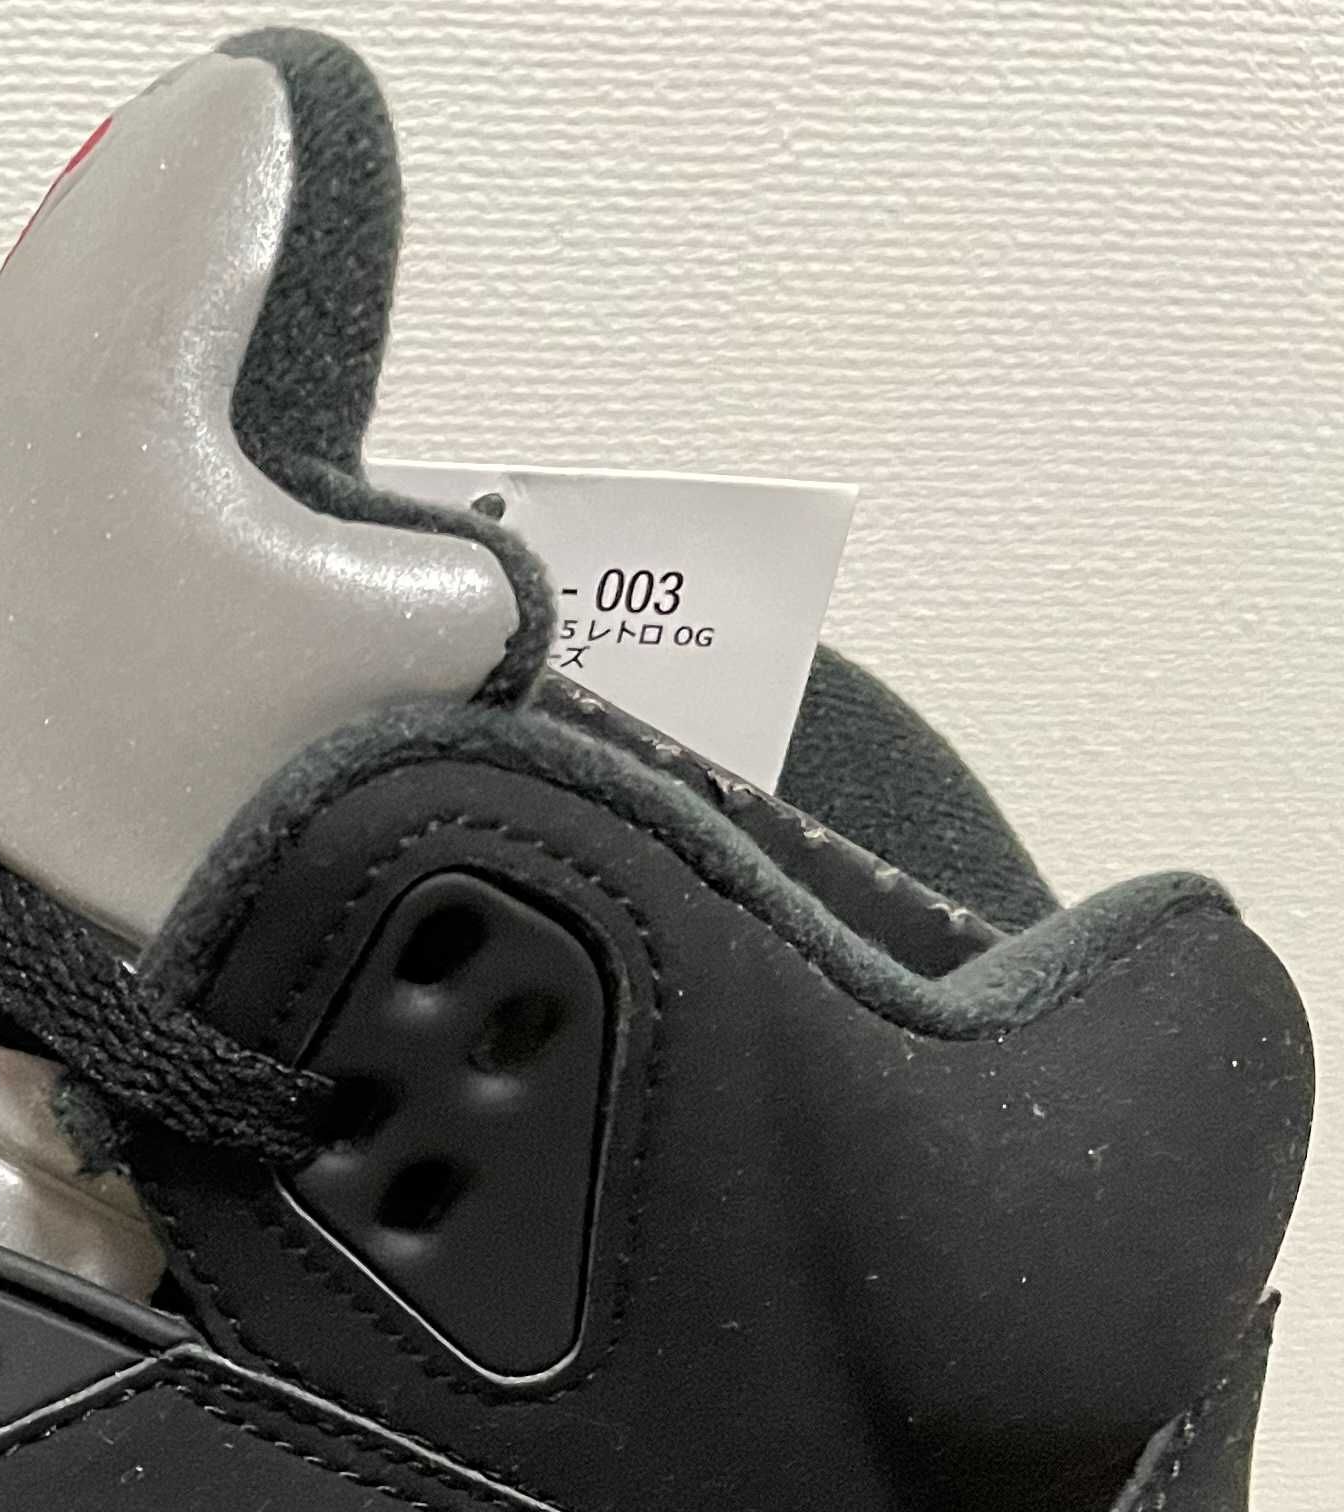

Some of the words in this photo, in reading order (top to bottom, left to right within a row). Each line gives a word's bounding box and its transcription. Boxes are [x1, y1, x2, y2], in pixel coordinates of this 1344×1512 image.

[595, 567, 684, 616] 003
[588, 619, 663, 645] レトロ
[673, 625, 715, 647] OG
